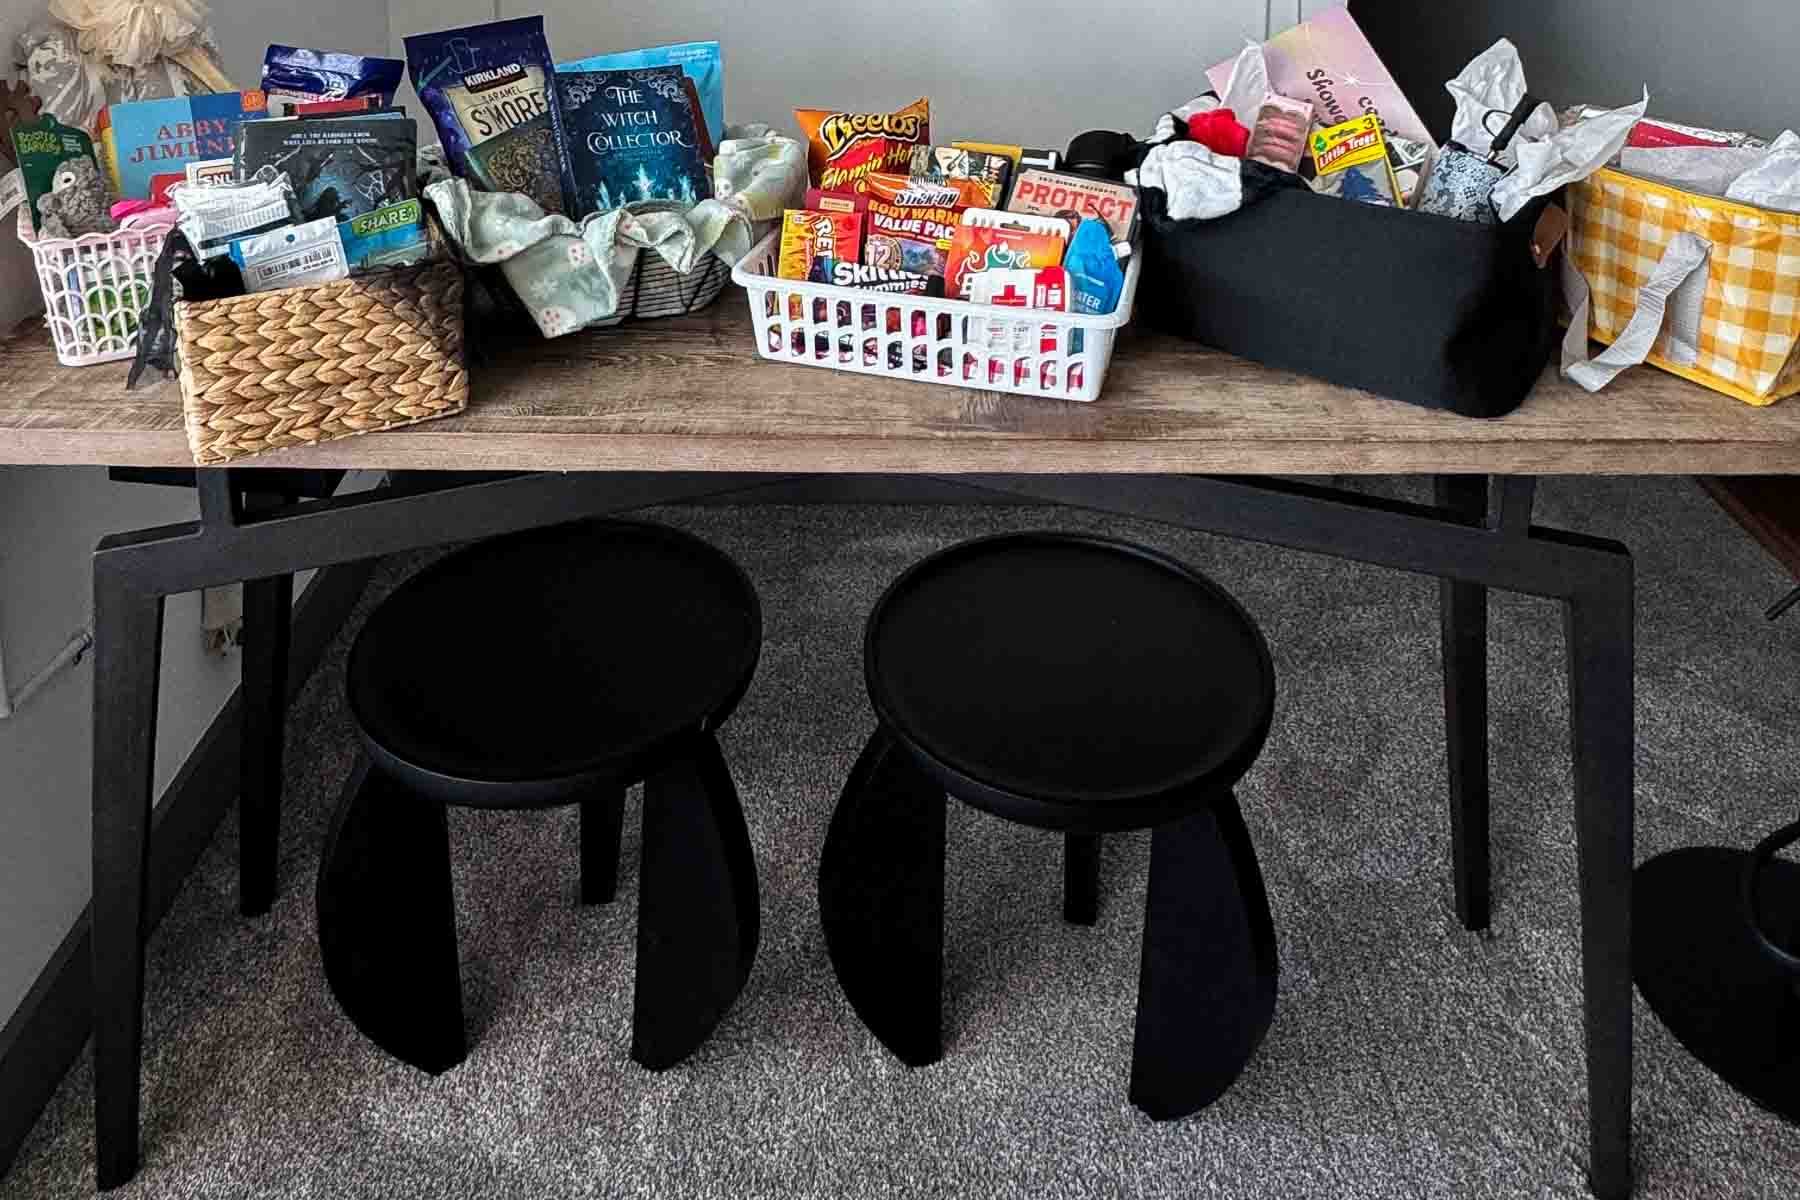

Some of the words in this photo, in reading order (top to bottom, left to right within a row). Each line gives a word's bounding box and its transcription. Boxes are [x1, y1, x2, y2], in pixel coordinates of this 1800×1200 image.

[465, 63, 521, 88] KIRKLAND
[604, 79, 644, 107] THE
[158, 119, 226, 140] ABBY
[601, 110, 659, 128] WITCH
[1363, 117, 1374, 129] 3
[587, 131, 697, 156] COLLECTOR
[1319, 144, 1346, 167] Little
[1346, 132, 1377, 150] Trees
[868, 200, 909, 219] BODY
[911, 208, 962, 225] WARM
[1016, 180, 1132, 224] PROTECT
[360, 208, 408, 232] SHARE
[874, 213, 922, 233] VALUE
[924, 221, 955, 239] PAC
[865, 243, 890, 267] 12
